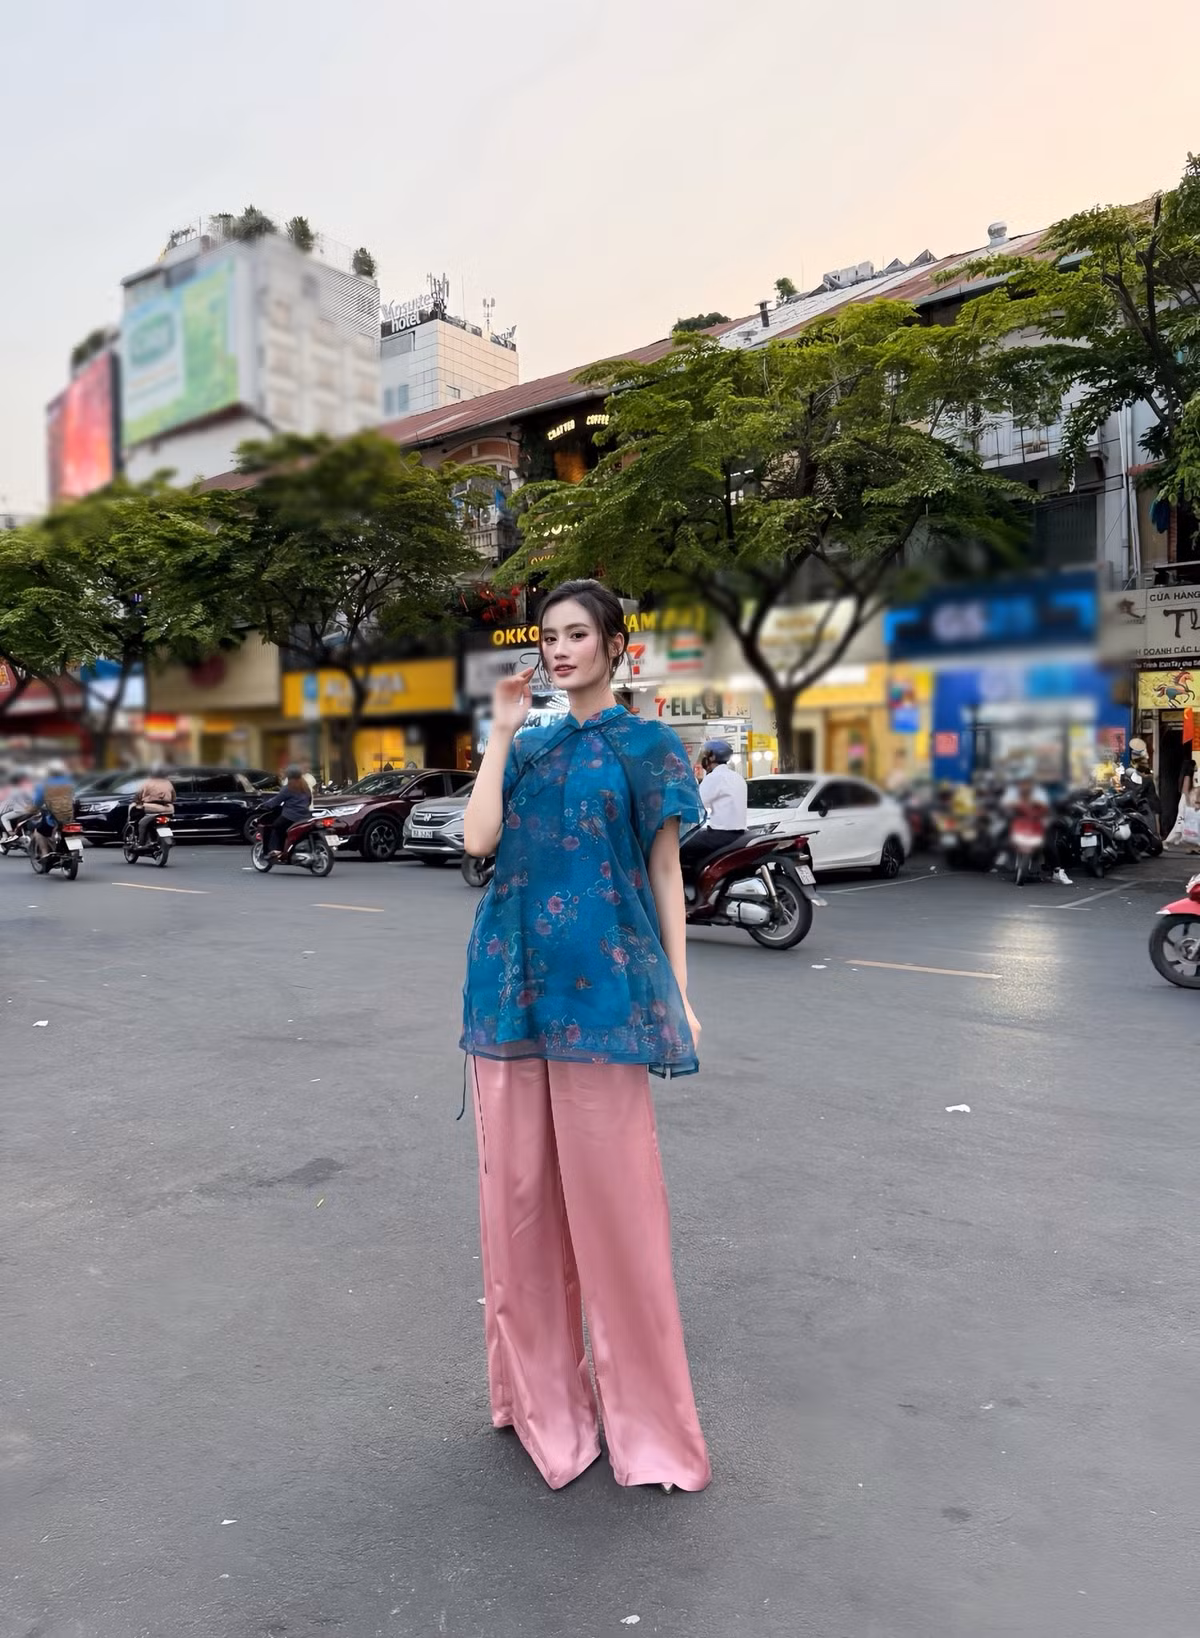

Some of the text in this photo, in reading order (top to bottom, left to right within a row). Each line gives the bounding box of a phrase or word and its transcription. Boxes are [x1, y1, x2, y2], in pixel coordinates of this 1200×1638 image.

[391, 311, 421, 333] hotel
[586, 414, 610, 425] COFFEE
[1143, 648, 1171, 656] DOANH
